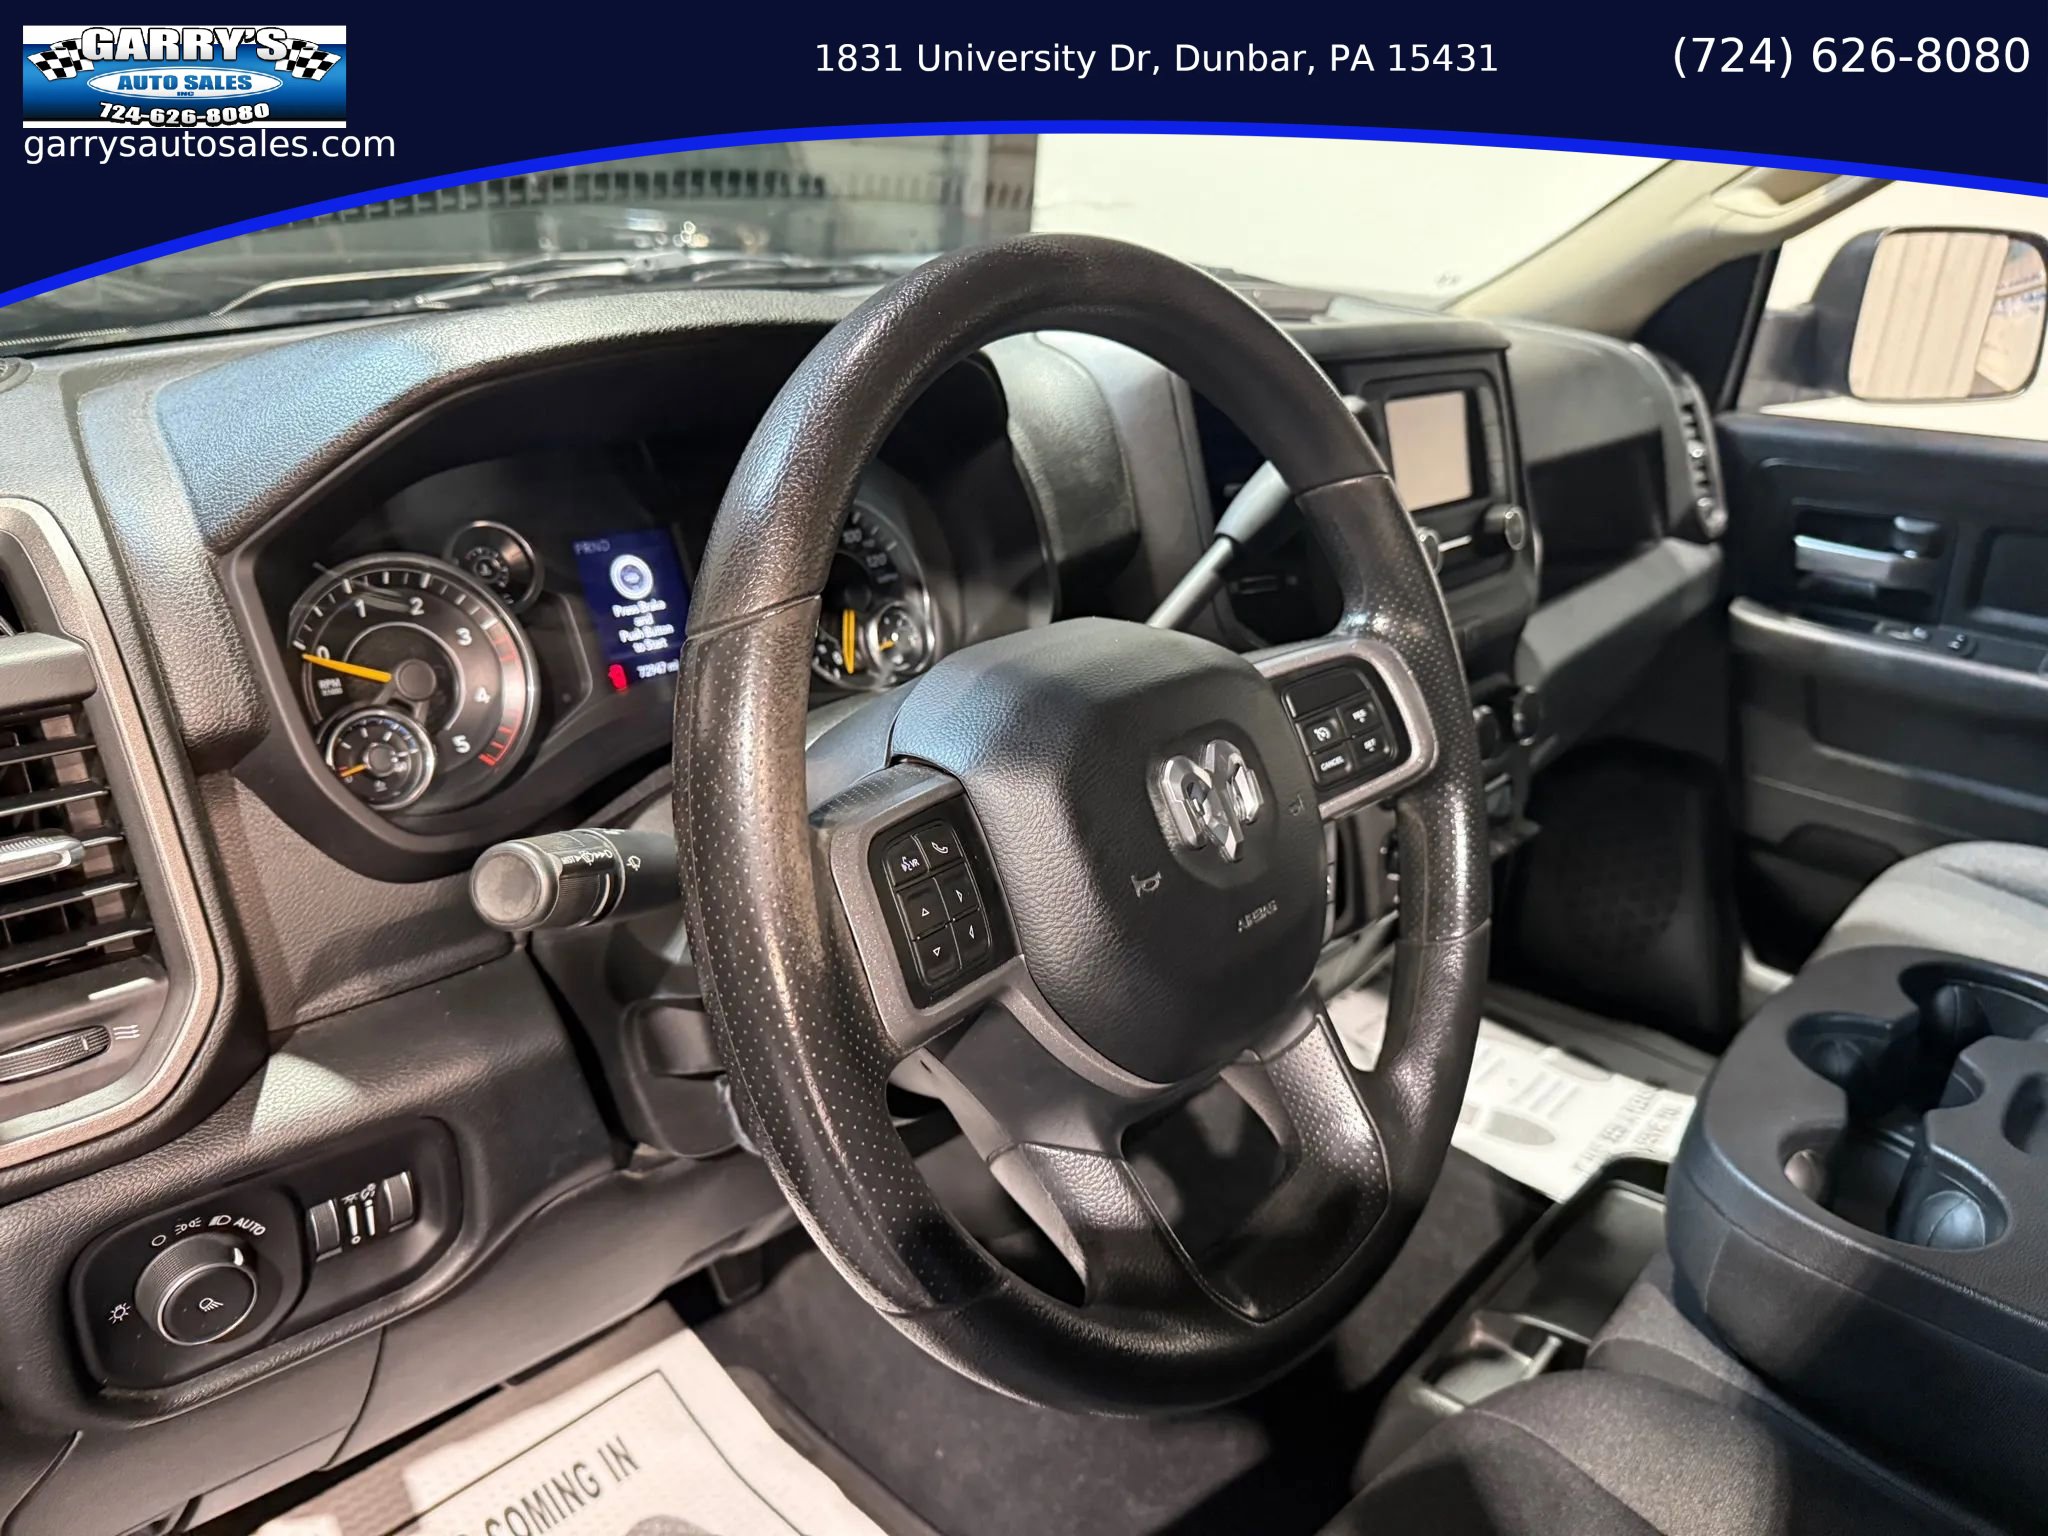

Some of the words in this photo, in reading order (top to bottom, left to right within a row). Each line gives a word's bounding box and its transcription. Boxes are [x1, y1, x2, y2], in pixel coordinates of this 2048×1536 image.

[355, 599, 366, 618] 1
[409, 597, 424, 616] 2
[456, 627, 472, 646] 3
[317, 677, 342, 690] RPM
[475, 687, 491, 704] 4
[452, 735, 470, 753] 5
[232, 1217, 267, 1237] AUTO
[597, 1434, 640, 1483] IN
